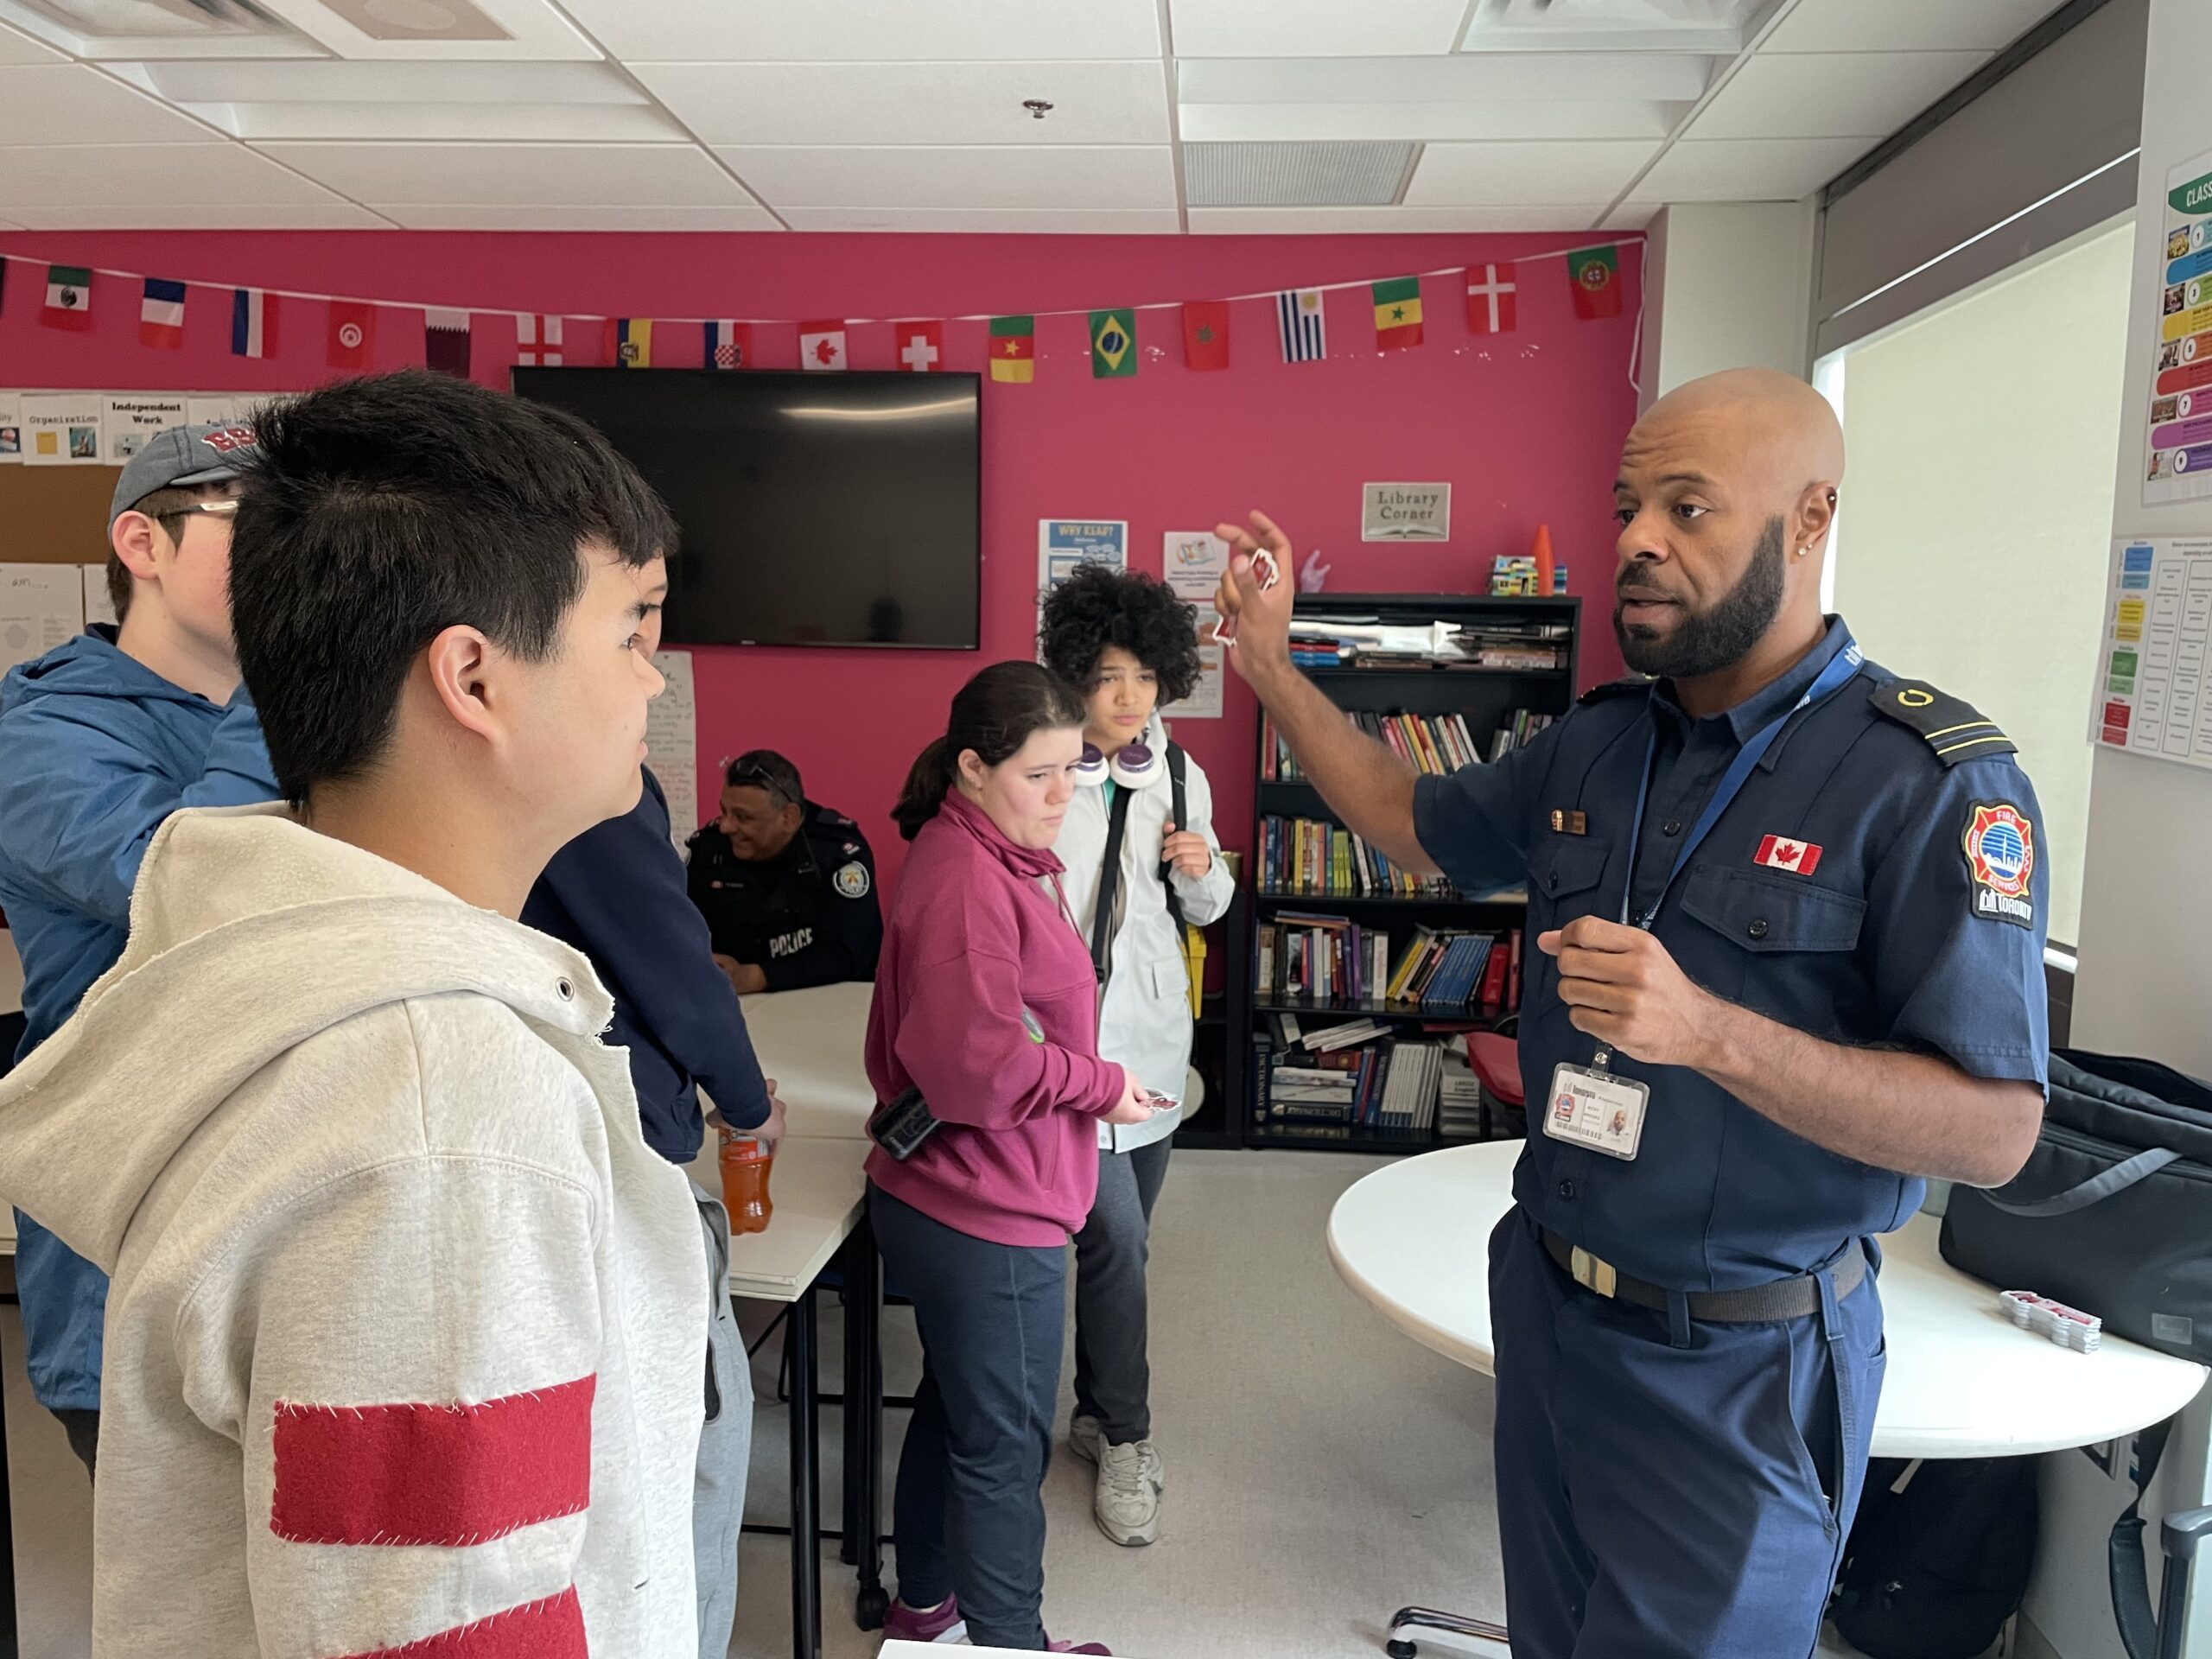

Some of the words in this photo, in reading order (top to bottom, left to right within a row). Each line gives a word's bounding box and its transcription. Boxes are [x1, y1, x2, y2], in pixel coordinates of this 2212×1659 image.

[111, 402, 181, 413] Independent
[132, 415, 163, 424] Work
[1377, 491, 1438, 507] Library
[1380, 506, 1433, 519] Corner
[1058, 524, 1081, 537] WHY
[1996, 810, 2017, 824] FIRE
[1997, 893, 2032, 920] TORONTO
[769, 927, 813, 959] POLICE
[1257, 1053, 1267, 1107] DICTIONARY
